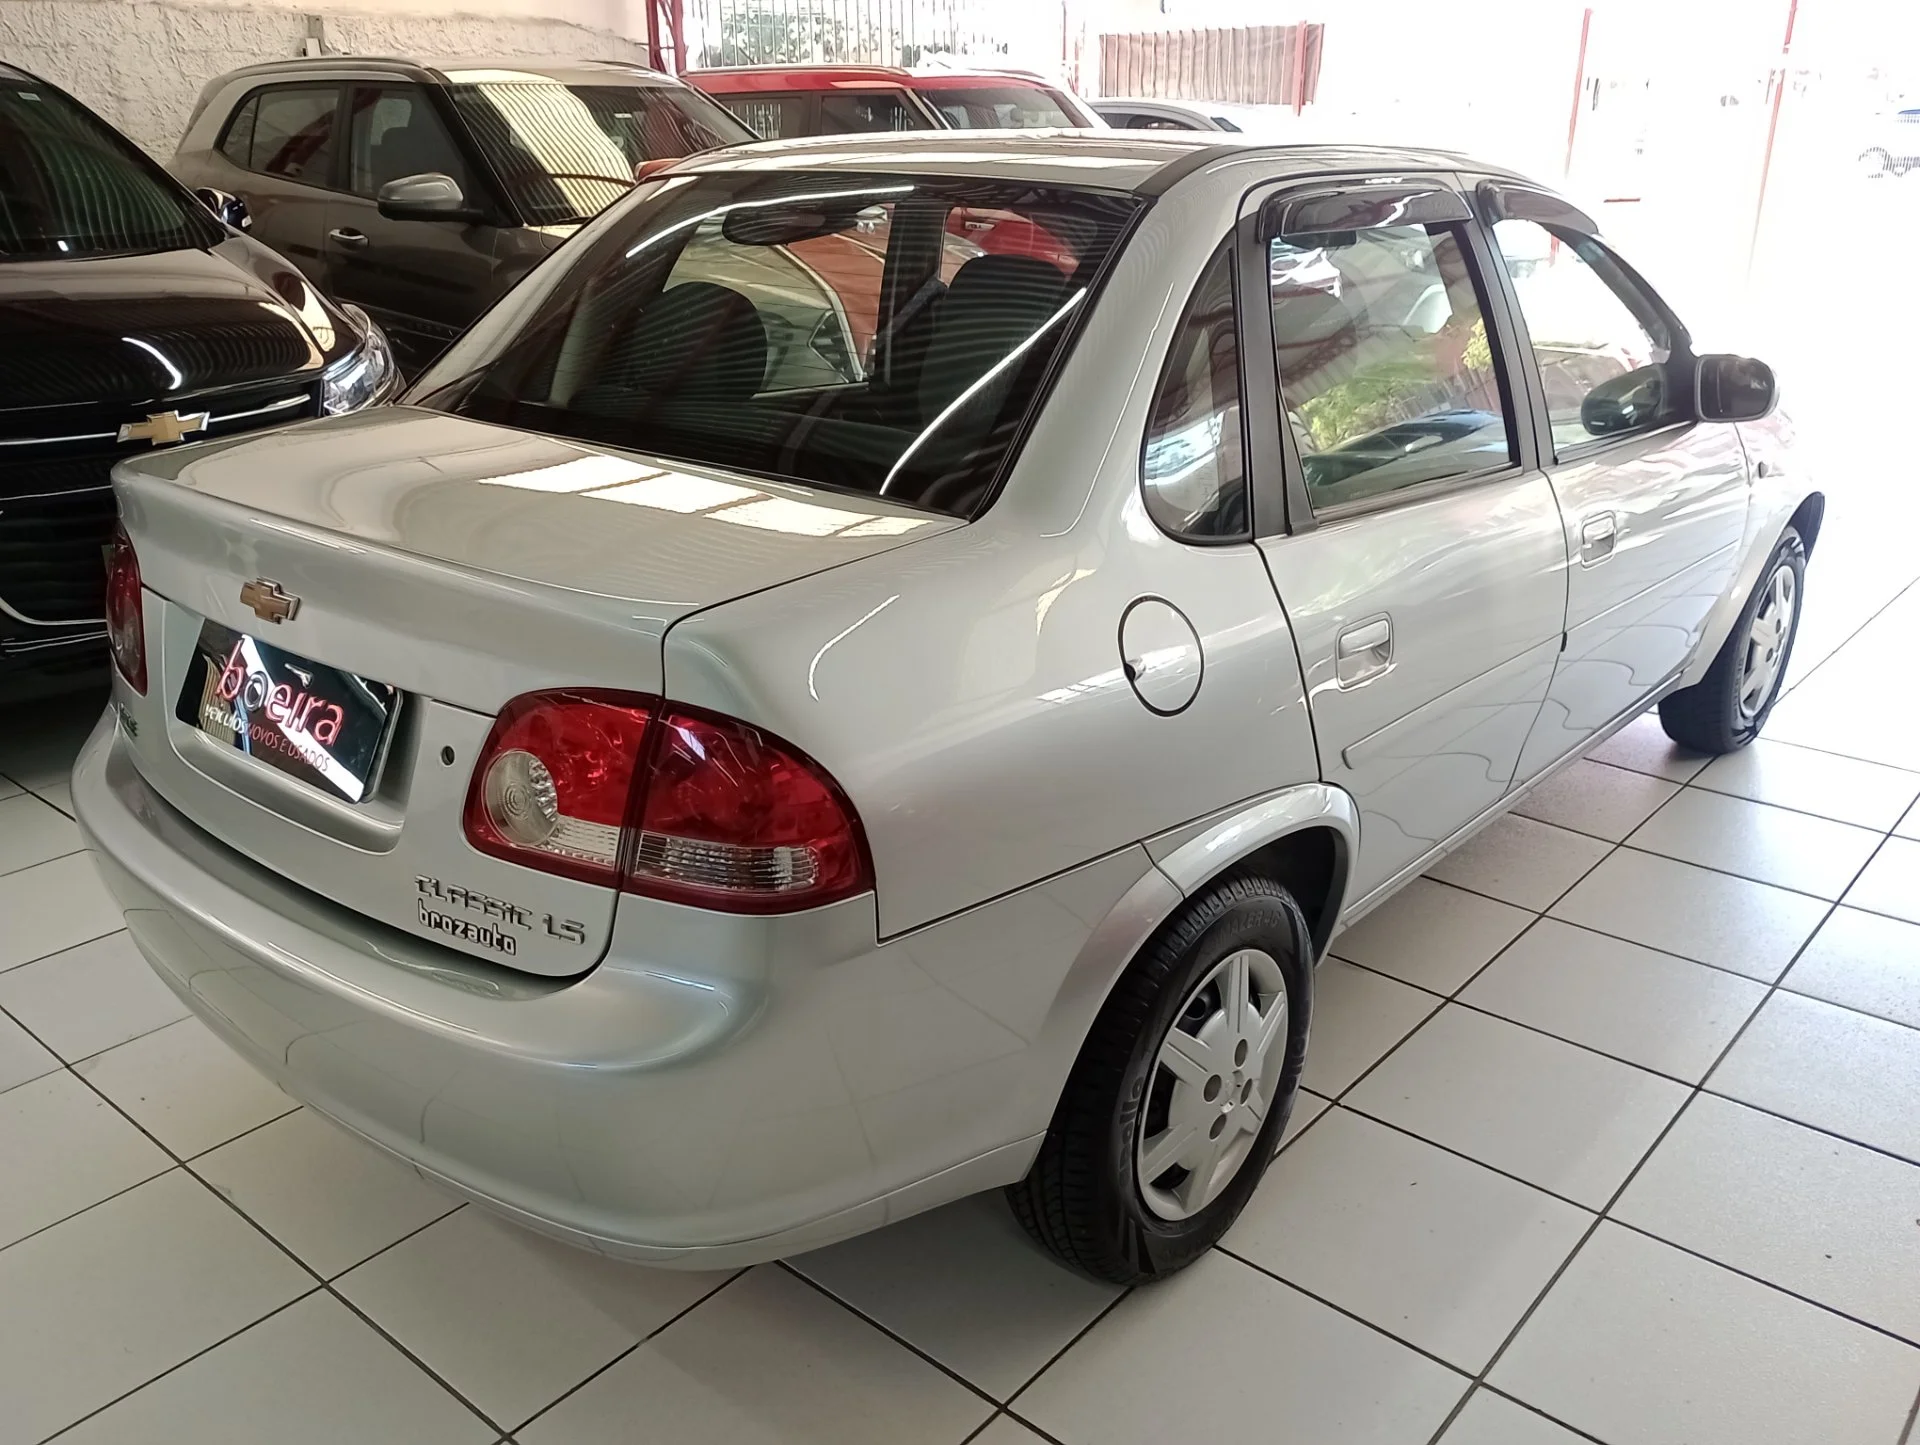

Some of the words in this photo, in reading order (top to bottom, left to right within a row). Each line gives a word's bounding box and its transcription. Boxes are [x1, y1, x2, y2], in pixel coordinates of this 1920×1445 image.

[214, 638, 345, 746] boeira
[280, 739, 287, 752] E
[414, 874, 533, 931] CLASSIC
[542, 913, 586, 945] LS
[417, 897, 518, 956] brozauto
